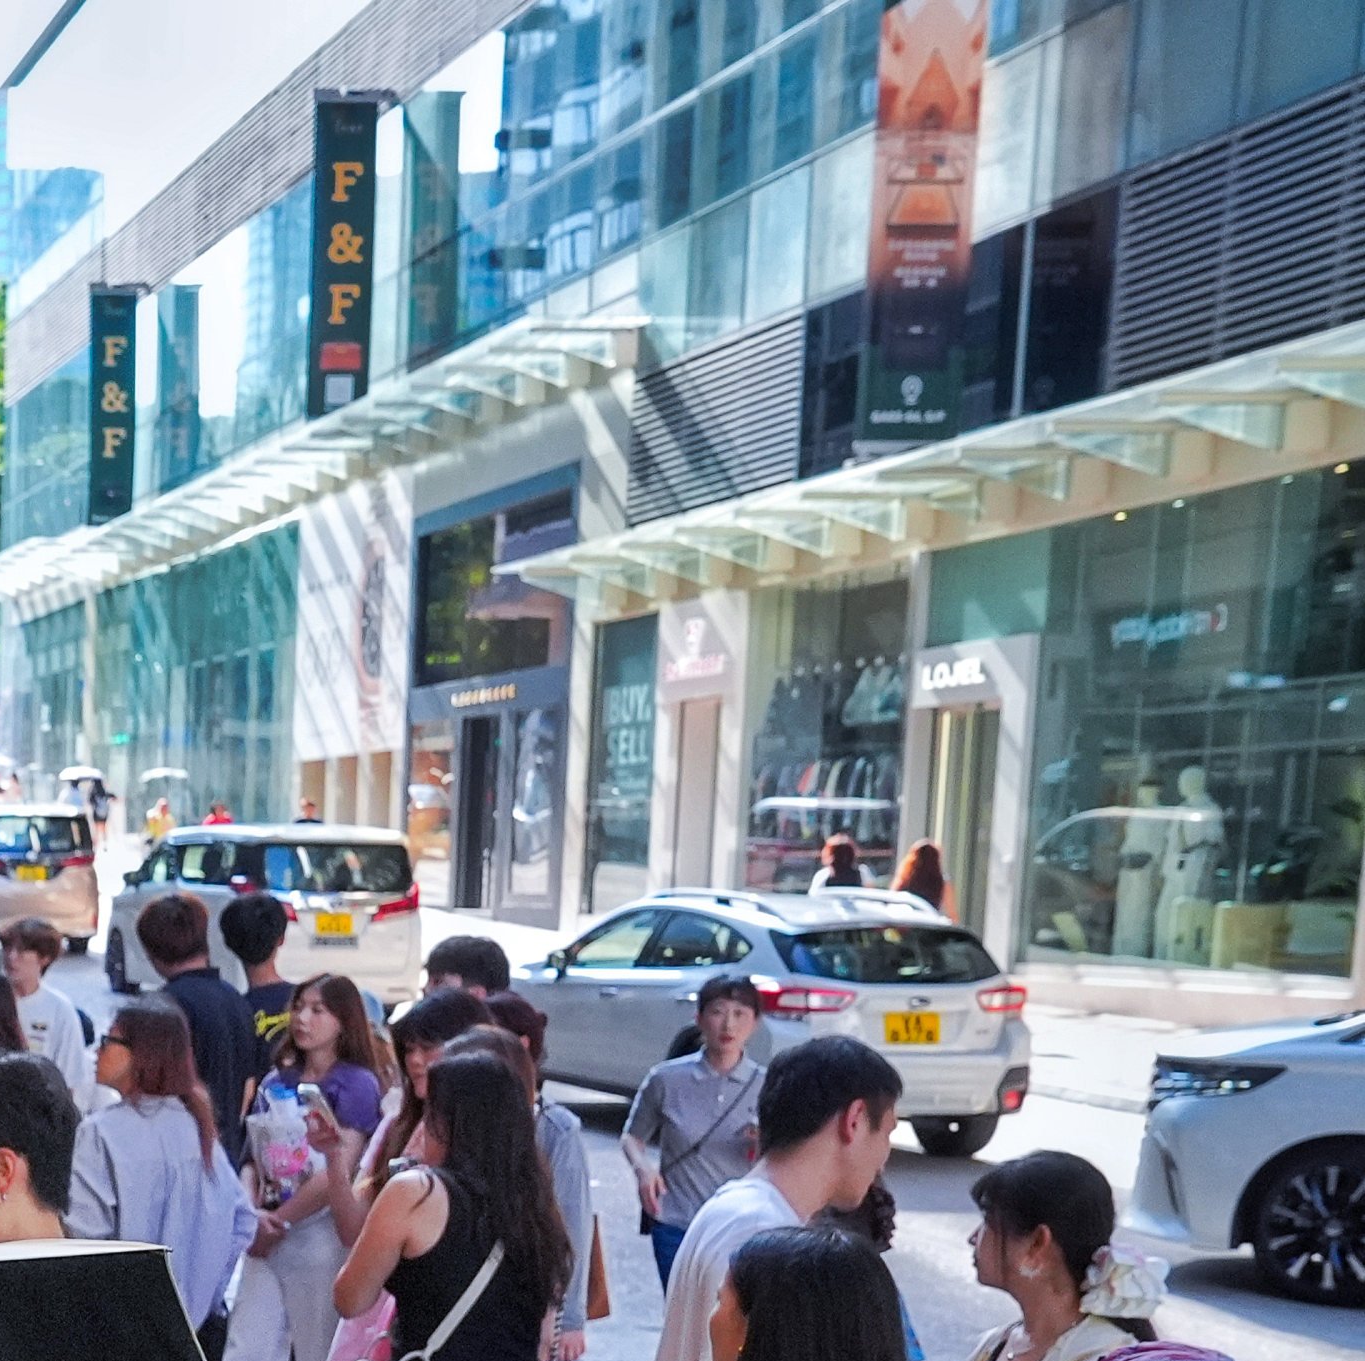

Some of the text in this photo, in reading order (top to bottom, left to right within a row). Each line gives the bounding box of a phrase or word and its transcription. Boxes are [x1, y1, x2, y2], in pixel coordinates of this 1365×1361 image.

[332, 162, 365, 202] F
[327, 223, 364, 264] &
[327, 284, 361, 325] F
[101, 335, 129, 458] F & F
[922, 657, 986, 690] LOJEL
